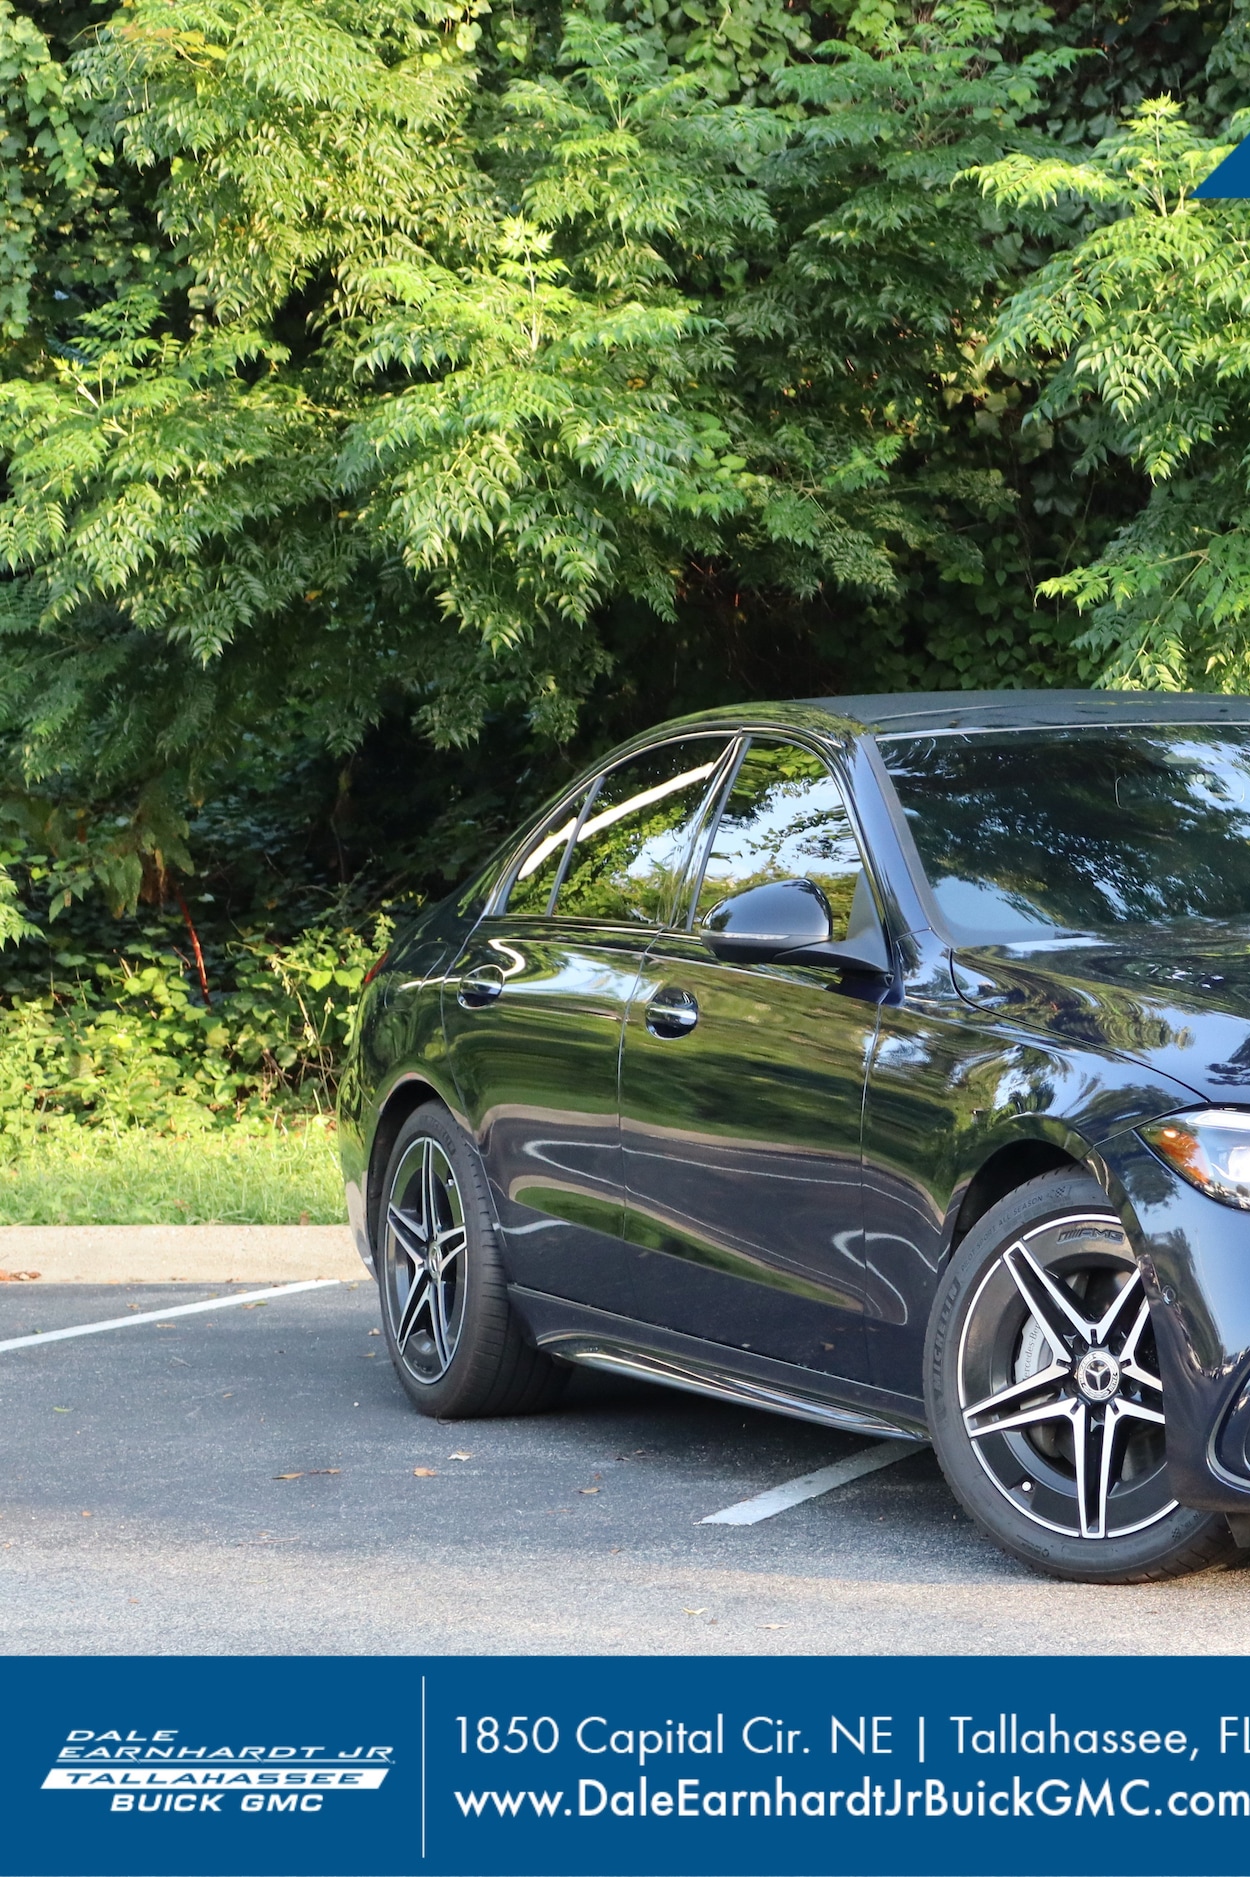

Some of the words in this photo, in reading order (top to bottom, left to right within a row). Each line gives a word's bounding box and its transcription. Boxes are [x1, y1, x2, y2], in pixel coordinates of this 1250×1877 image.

[999, 1211, 1012, 1225] ALL
[1013, 1195, 1043, 1213] SEASON
[932, 1276, 961, 1400] MICHELIN
[1022, 1321, 1041, 1381] ercedes-Ben
